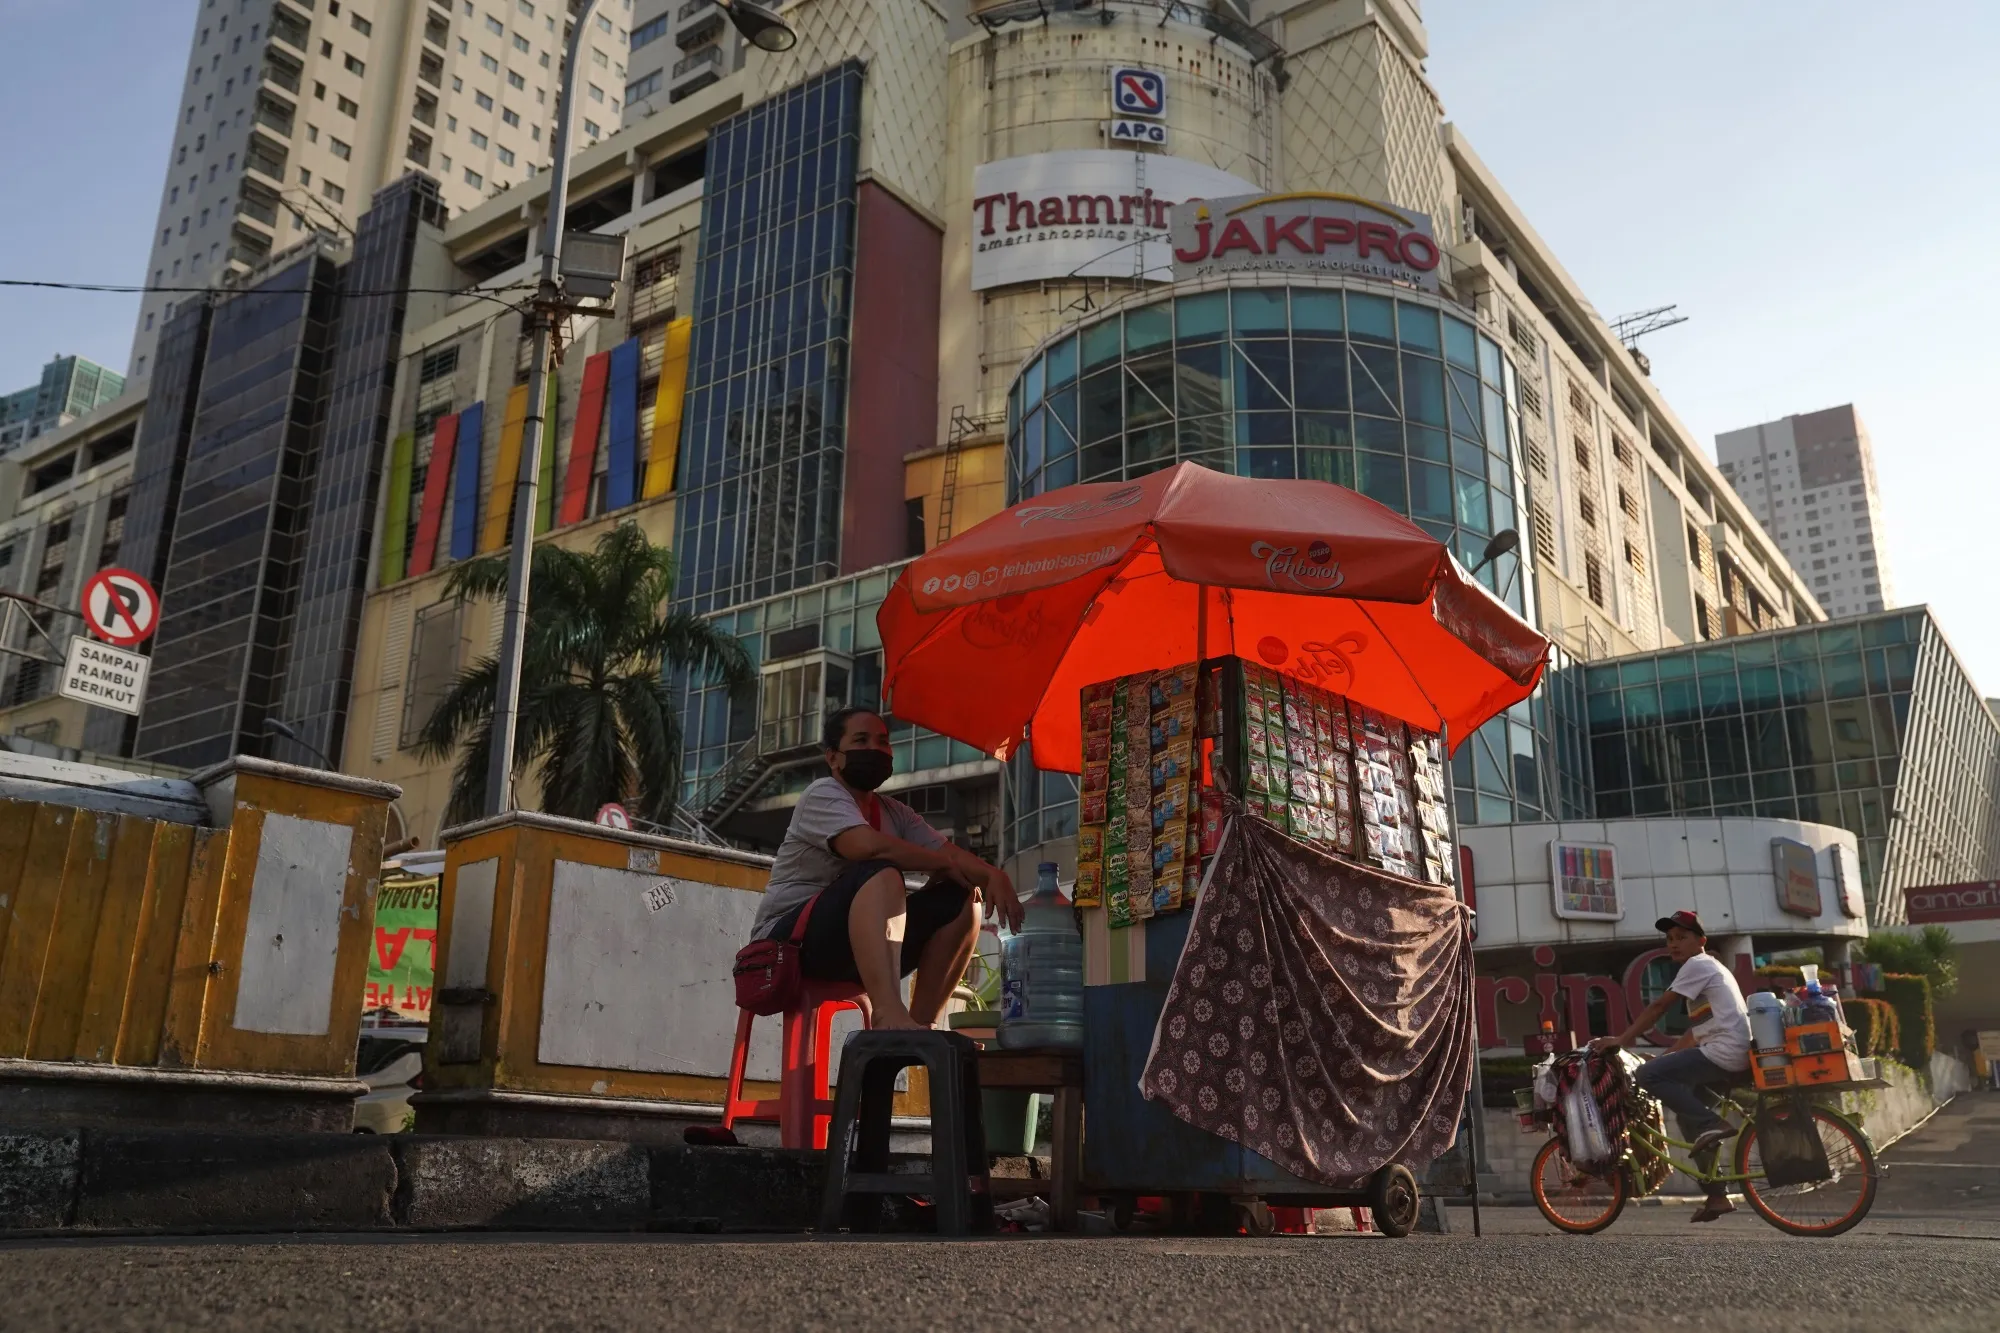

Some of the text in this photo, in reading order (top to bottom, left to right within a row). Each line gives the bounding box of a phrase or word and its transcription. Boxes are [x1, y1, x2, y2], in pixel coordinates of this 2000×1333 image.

[1115, 122, 1164, 142] APG
[978, 233, 1033, 252] smart
[1038, 227, 1127, 242] shopping
[1175, 214, 1440, 271] JAKPRO
[1196, 259, 1424, 283] PT JAKARTA PROPERTINDO
[1308, 547, 1331, 559] SOSRO
[80, 647, 140, 673] SAMPAI
[78, 663, 134, 688] RAMBU
[69, 677, 136, 705] BERIKUT
[1910, 883, 2000, 911] amari
[374, 927, 437, 971] LA
[366, 982, 433, 1012] AT PE
